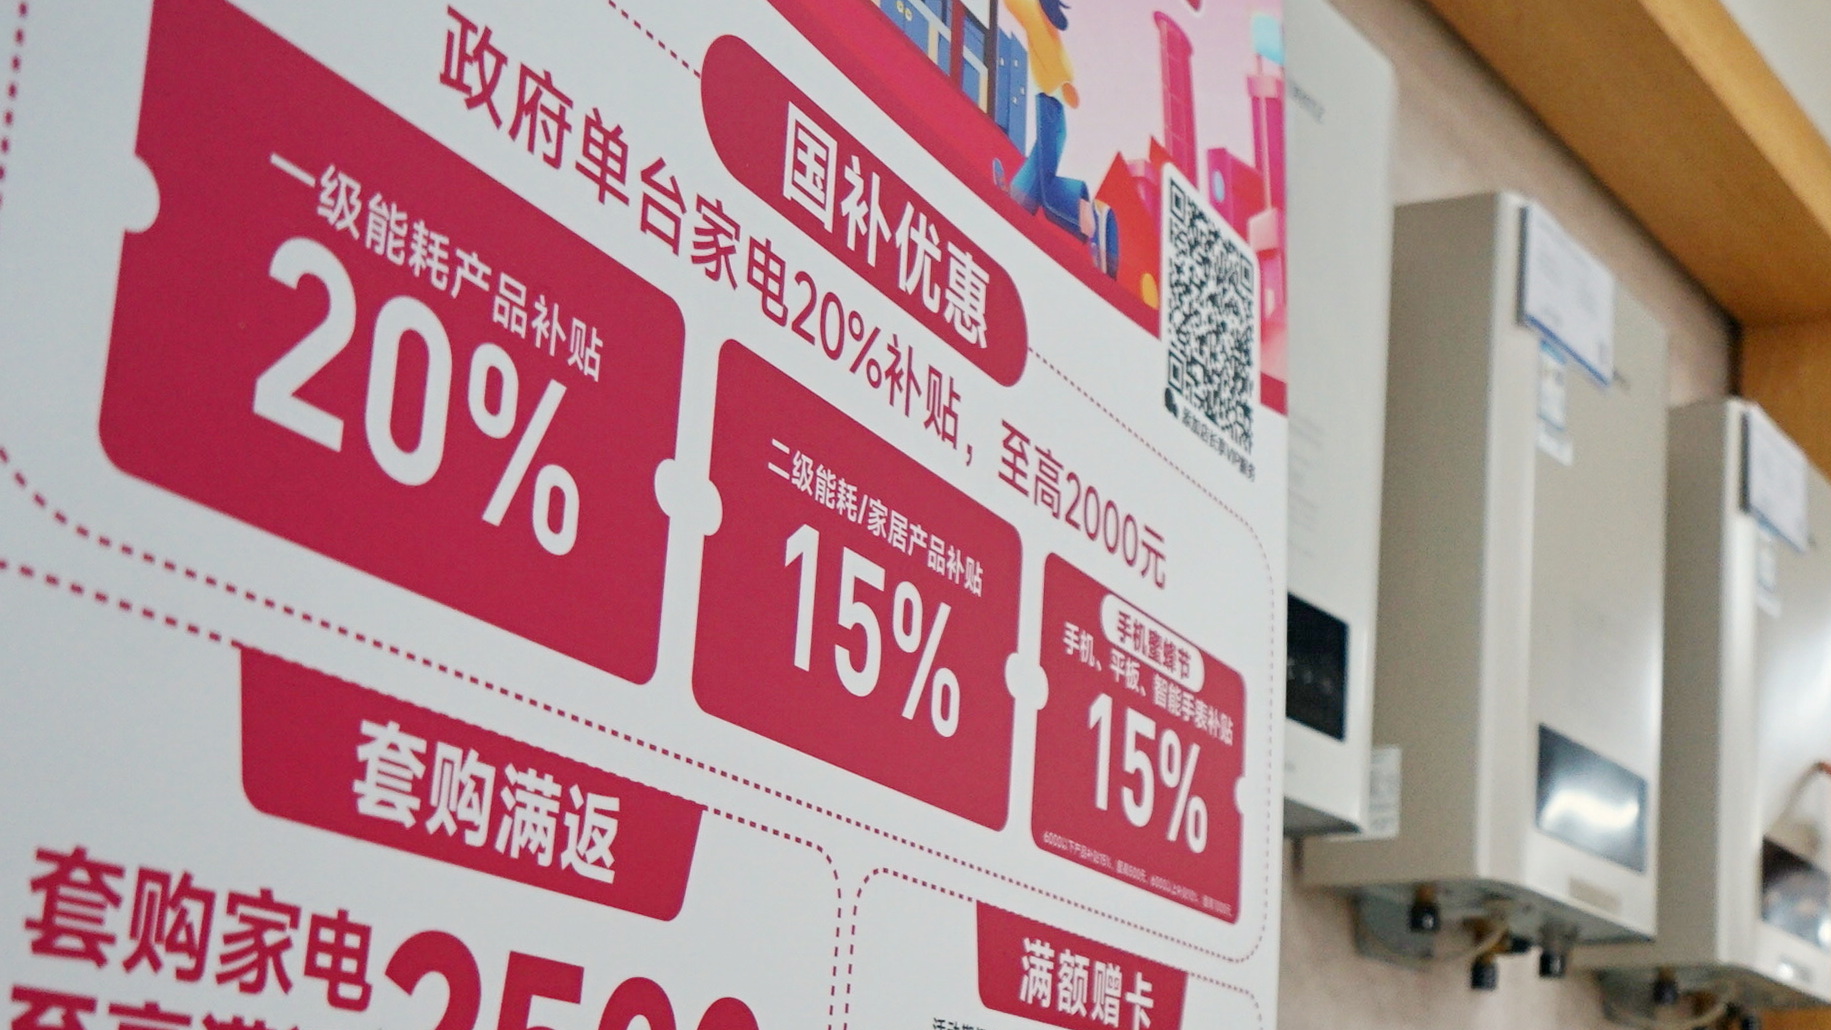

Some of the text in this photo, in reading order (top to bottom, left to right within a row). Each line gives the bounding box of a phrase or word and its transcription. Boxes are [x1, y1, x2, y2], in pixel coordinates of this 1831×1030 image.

[269, 152, 604, 382] 一级能耗产品补贴
[782, 100, 990, 349] 国补优惠
[252, 236, 580, 556] 20%
[767, 438, 983, 597] 二级能耗/家居产品补贴
[784, 523, 960, 738] 15%
[1063, 620, 1234, 747] 手机、平板、智能手表补贴
[352, 718, 621, 885] 套购满返
[1087, 692, 1209, 853] 15%
[24, 845, 374, 1013] 套购家电
